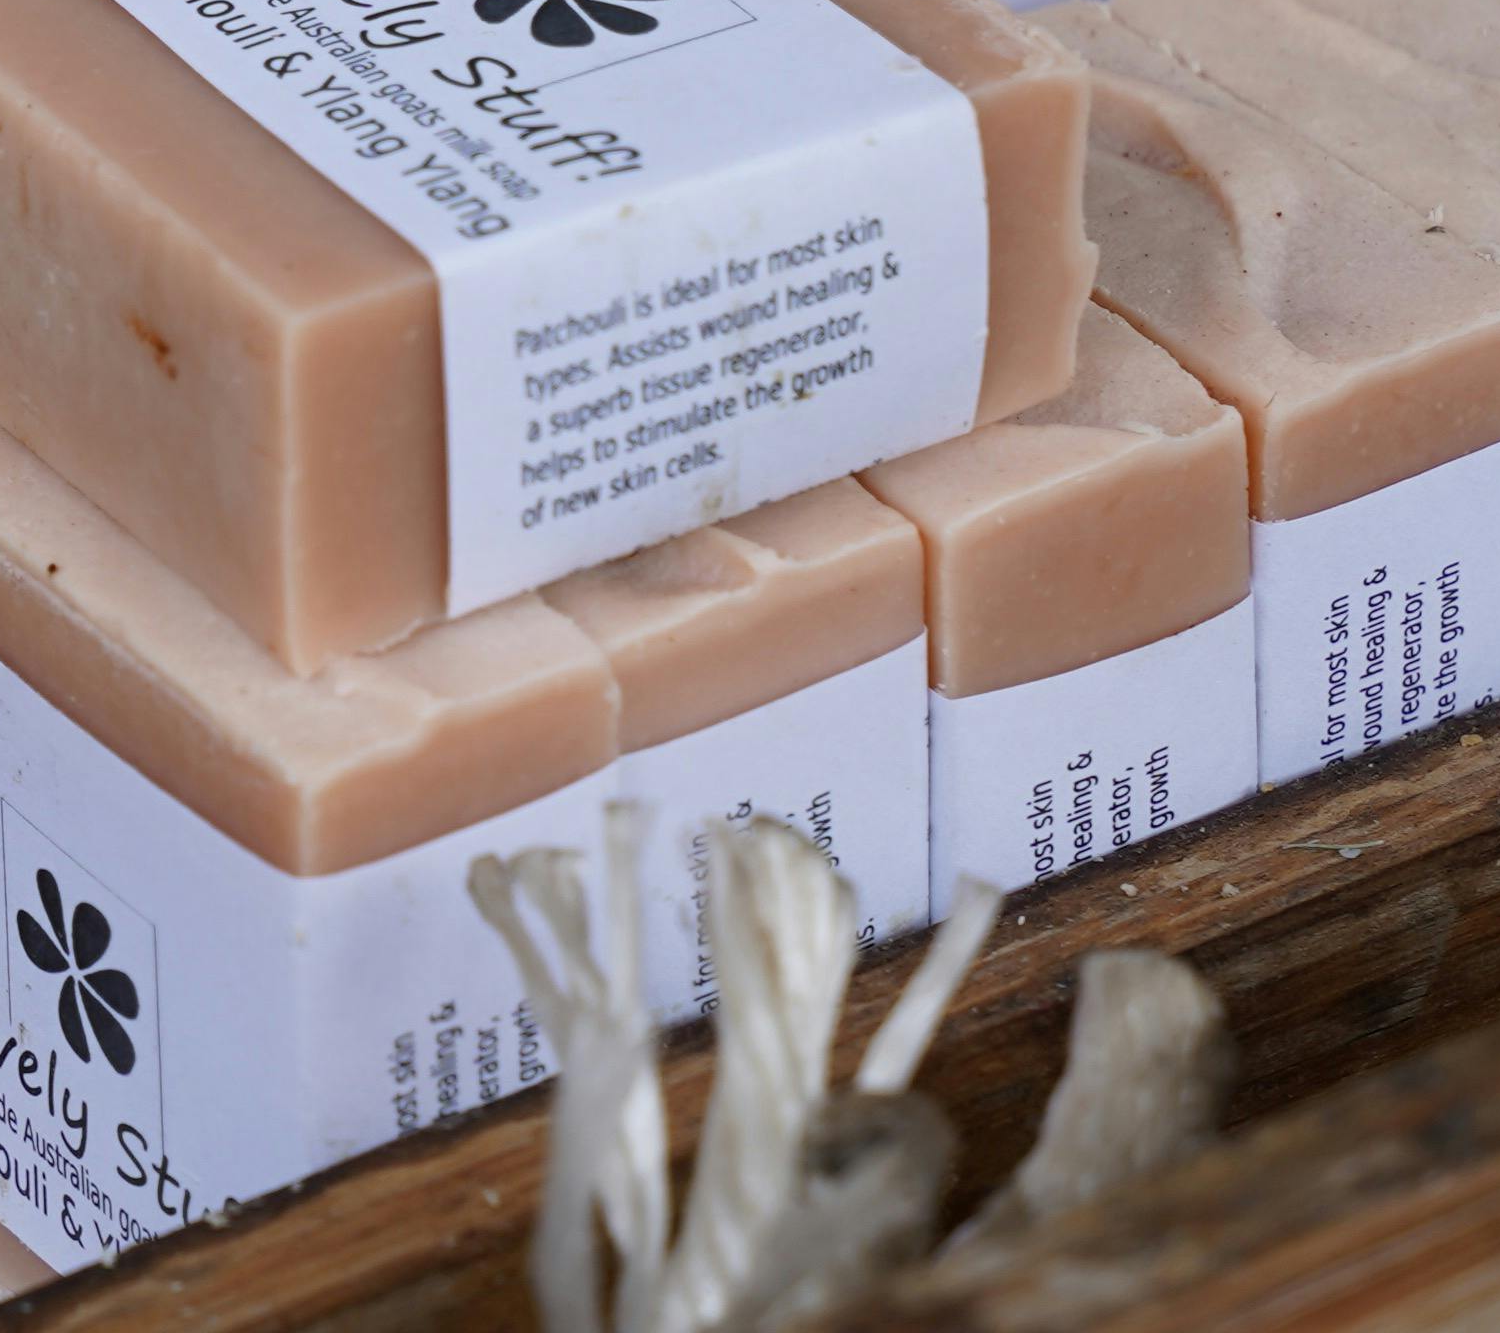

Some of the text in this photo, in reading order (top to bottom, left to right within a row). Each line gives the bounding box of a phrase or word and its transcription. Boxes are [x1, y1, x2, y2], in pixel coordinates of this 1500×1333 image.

[279, 5, 391, 86] Australian
[369, 81, 446, 129] goats
[262, 50, 313, 80] &
[300, 74, 410, 160] Ylang
[401, 152, 512, 241] Ylang
[430, 55, 644, 183] Stuff!
[515, 215, 885, 359] Patchouli is ideal for most skin
[606, 323, 692, 373] Assists
[697, 292, 779, 341] wound
[785, 263, 874, 313] healing
[881, 250, 900, 280] &
[519, 345, 875, 488] helps to stimulate the growth
[525, 419, 541, 443] a
[548, 386, 635, 437] superb
[639, 361, 713, 406] tissue
[520, 440, 726, 531] of new skin cells.
[1324, 594, 1350, 644] skin
[1360, 565, 1392, 680] healing &
[1436, 561, 1464, 643] growth
[1324, 647, 1349, 708] most
[1401, 581, 1427, 725] regenerator,
[1433, 648, 1458, 690] the
[1321, 713, 1346, 746] for
[726, 798, 752, 821] &
[1026, 779, 1053, 830] skin
[1066, 750, 1099, 867] healing &
[1109, 766, 1135, 847] erator,
[1144, 745, 1175, 829] growth
[474, 1015, 501, 1102] erator,
[393, 1086, 418, 1131] ost
[23, 1117, 113, 1221] Australian
[61, 1194, 85, 1249] &
